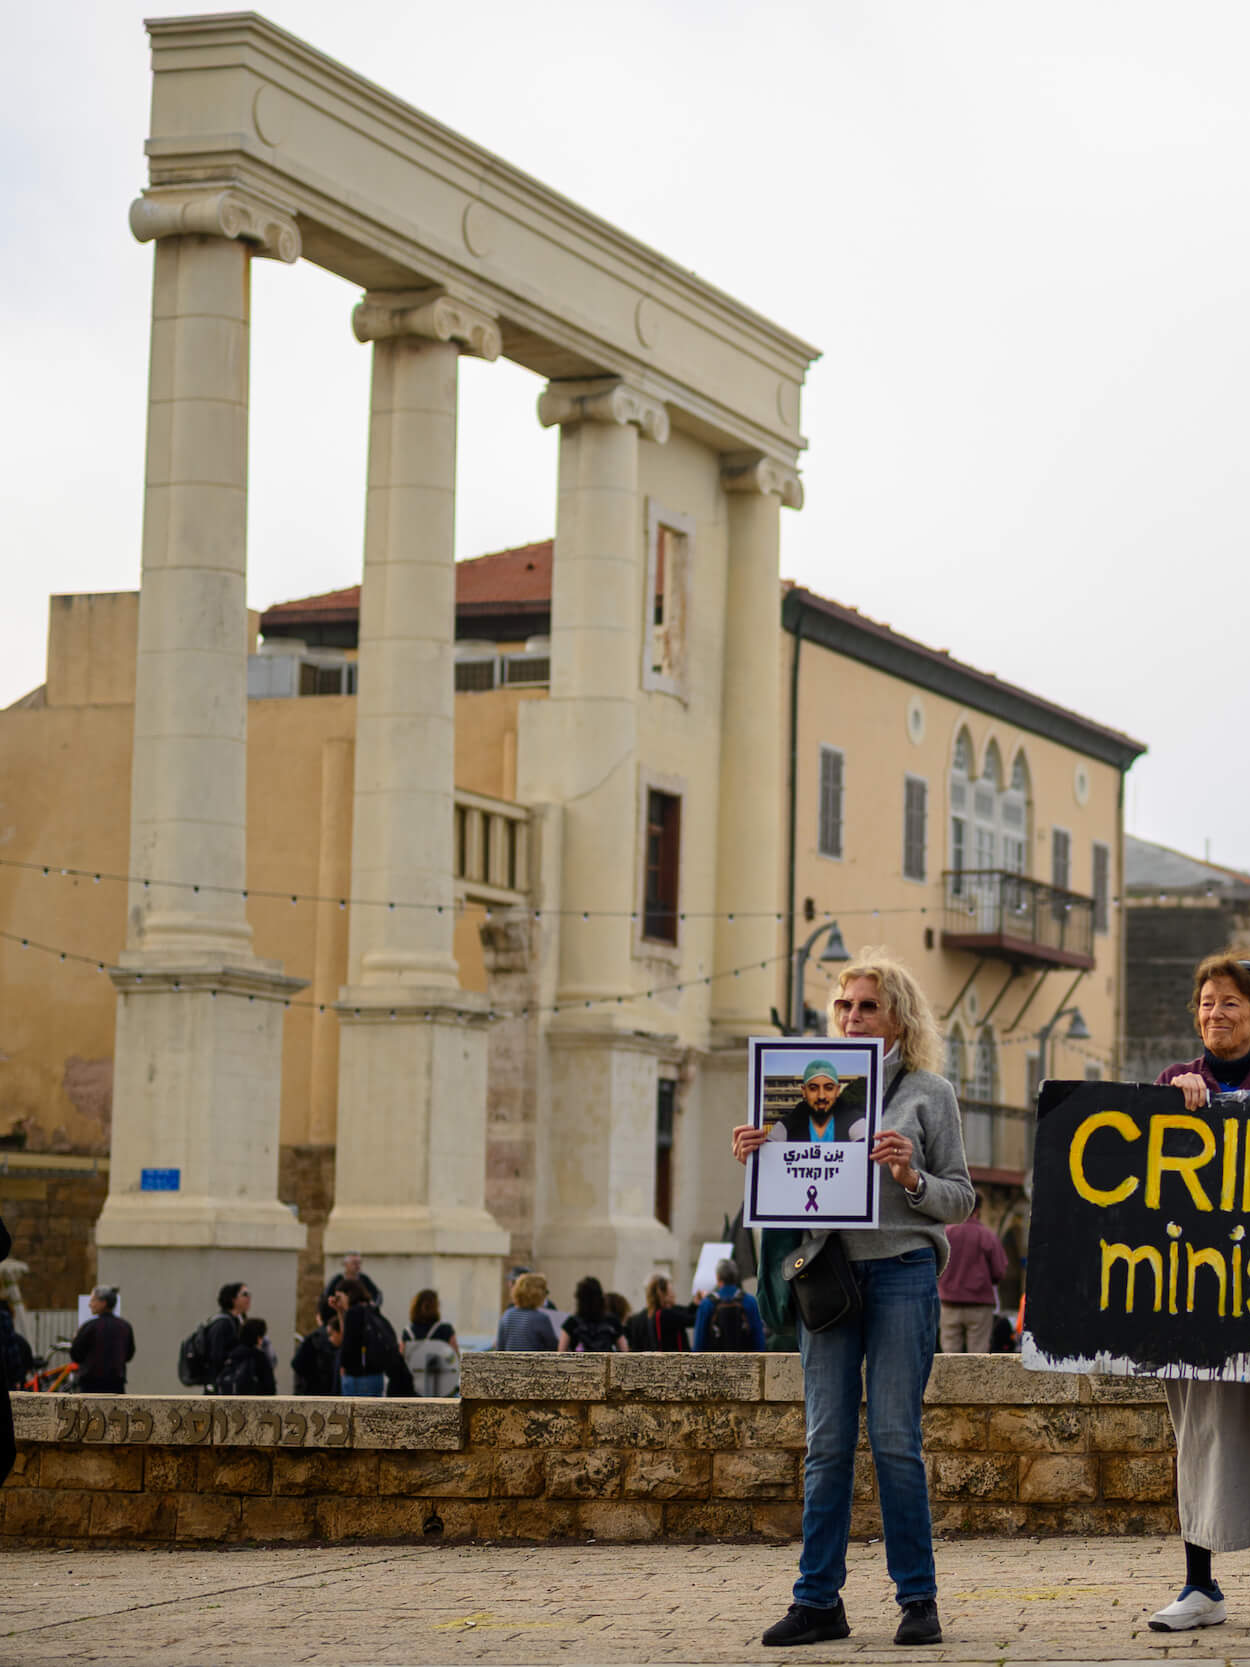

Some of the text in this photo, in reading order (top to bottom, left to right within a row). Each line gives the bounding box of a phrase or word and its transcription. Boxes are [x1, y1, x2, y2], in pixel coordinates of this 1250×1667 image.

[784, 1145, 844, 1165] يزن قادري
[787, 1167, 839, 1181] יזן קאדרי
[57, 1397, 350, 1446] כיכר יוסי כרמל
